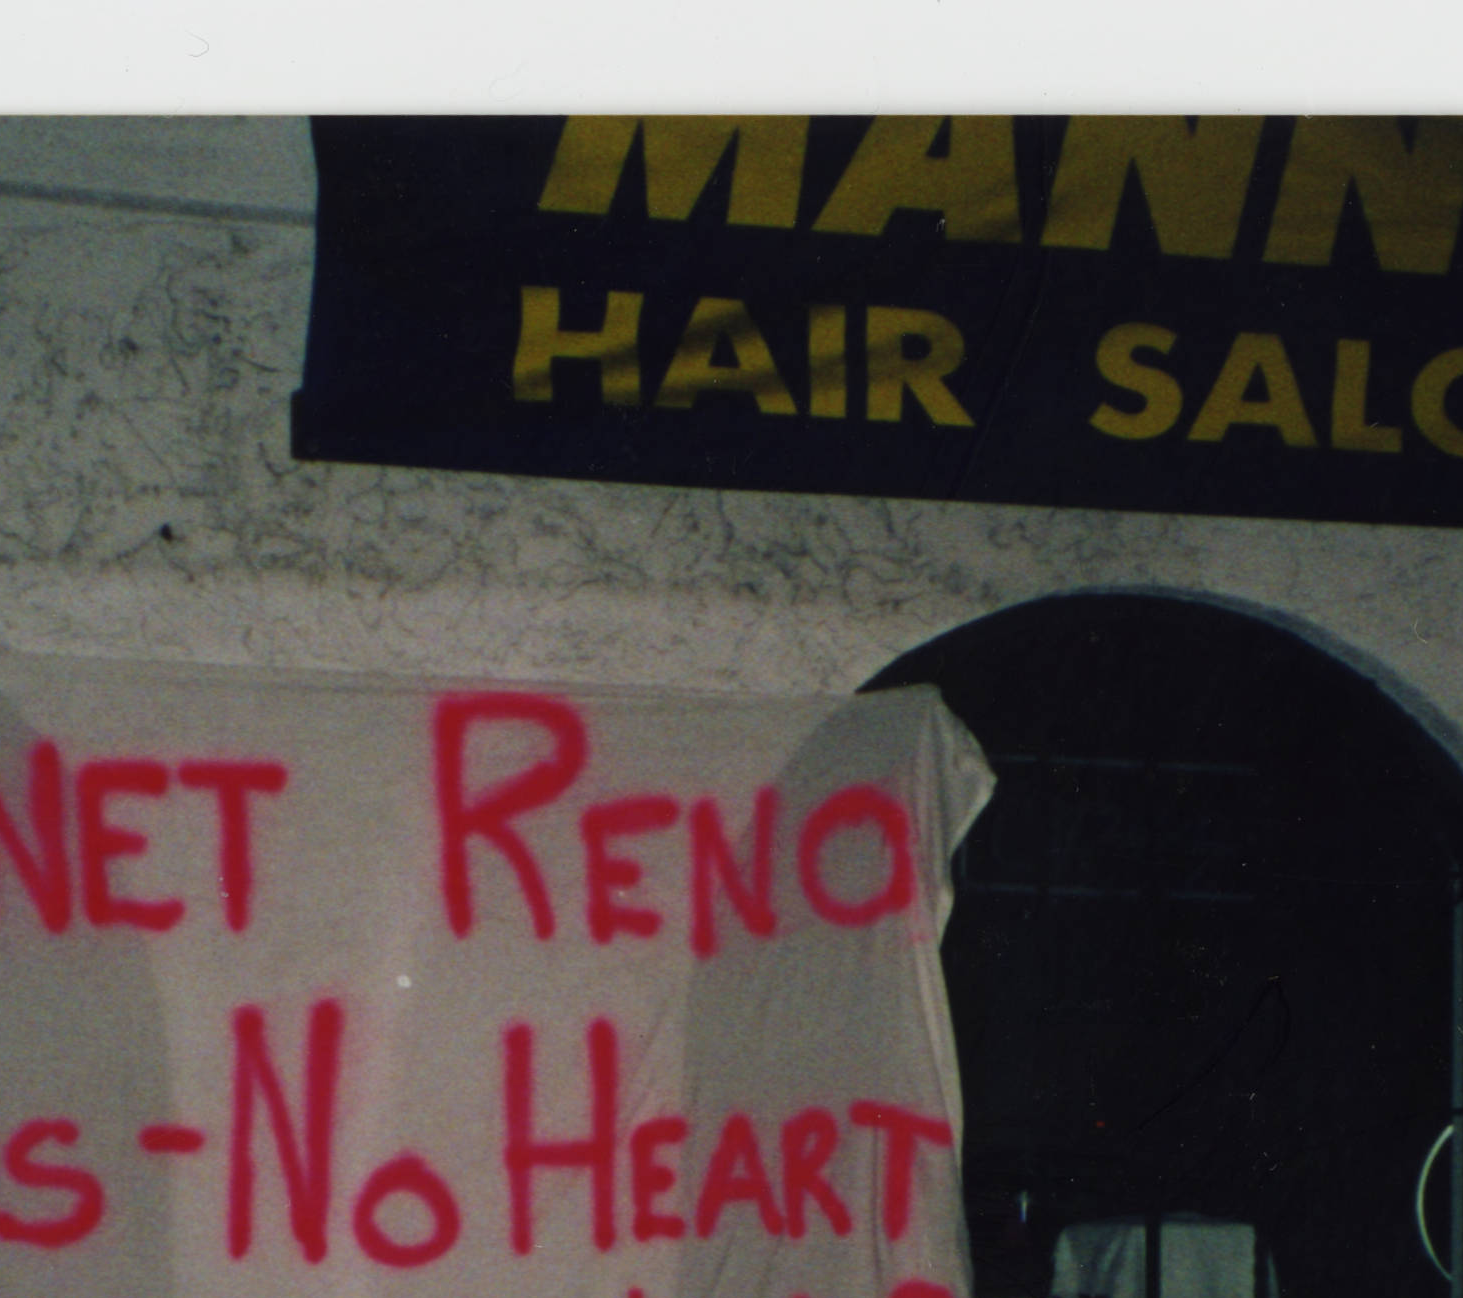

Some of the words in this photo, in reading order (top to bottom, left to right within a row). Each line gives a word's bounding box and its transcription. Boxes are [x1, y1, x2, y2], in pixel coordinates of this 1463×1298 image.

[512, 285, 975, 428] HAIR
[430, 690, 917, 958] RENO
[500, 1016, 953, 1257] HEART
